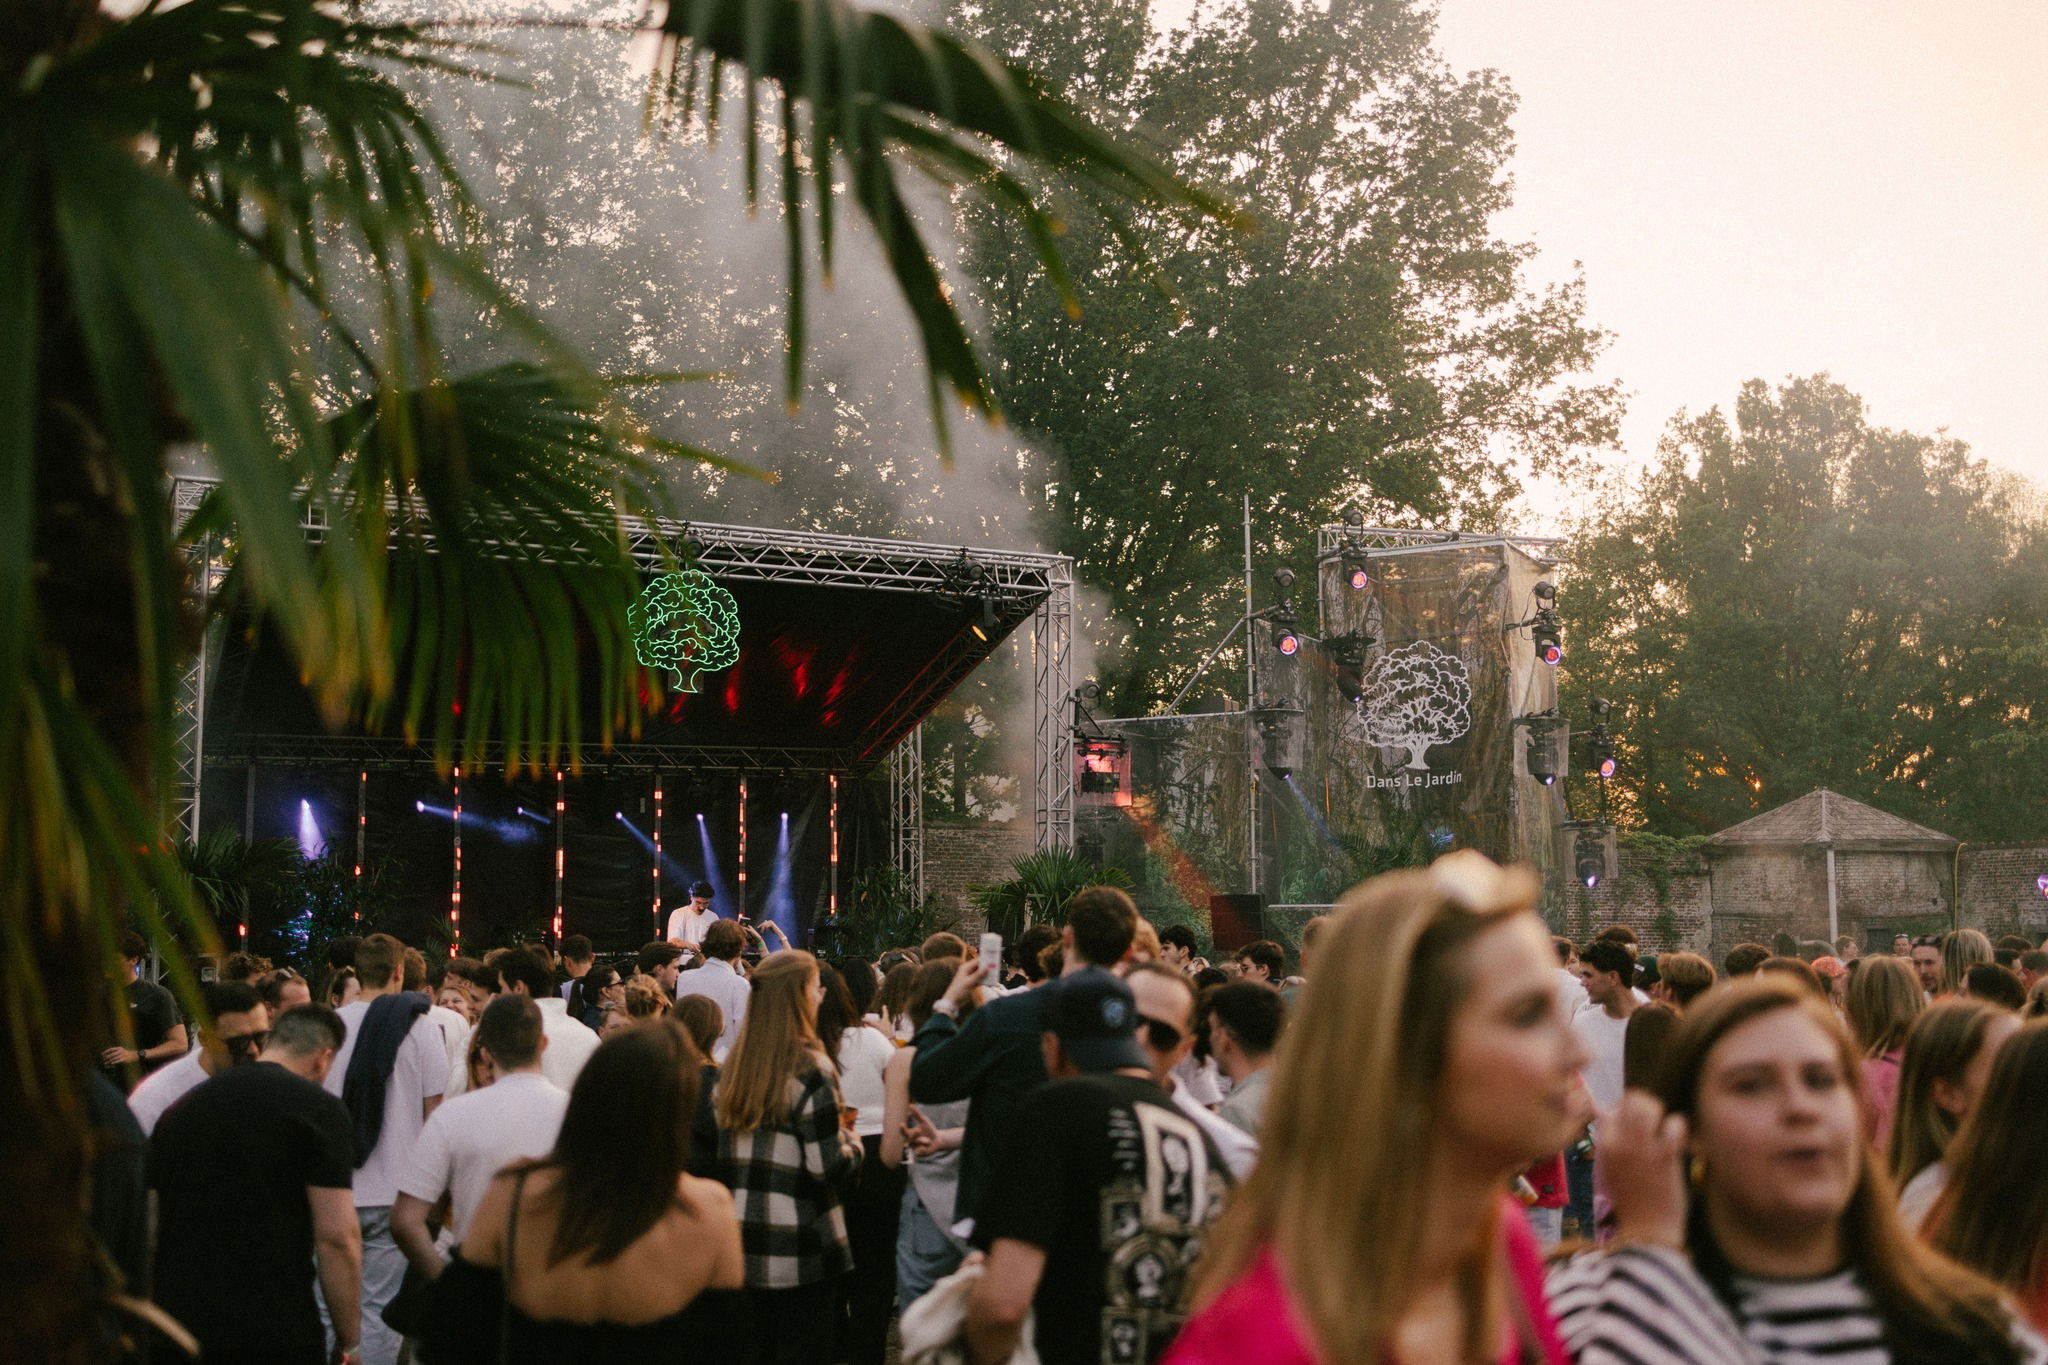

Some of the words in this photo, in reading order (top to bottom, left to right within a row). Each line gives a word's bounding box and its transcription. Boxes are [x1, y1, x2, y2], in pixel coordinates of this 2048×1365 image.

[1367, 775, 1401, 789] Dans
[1406, 774, 1423, 787] Le
[1425, 770, 1462, 788] Jardin
